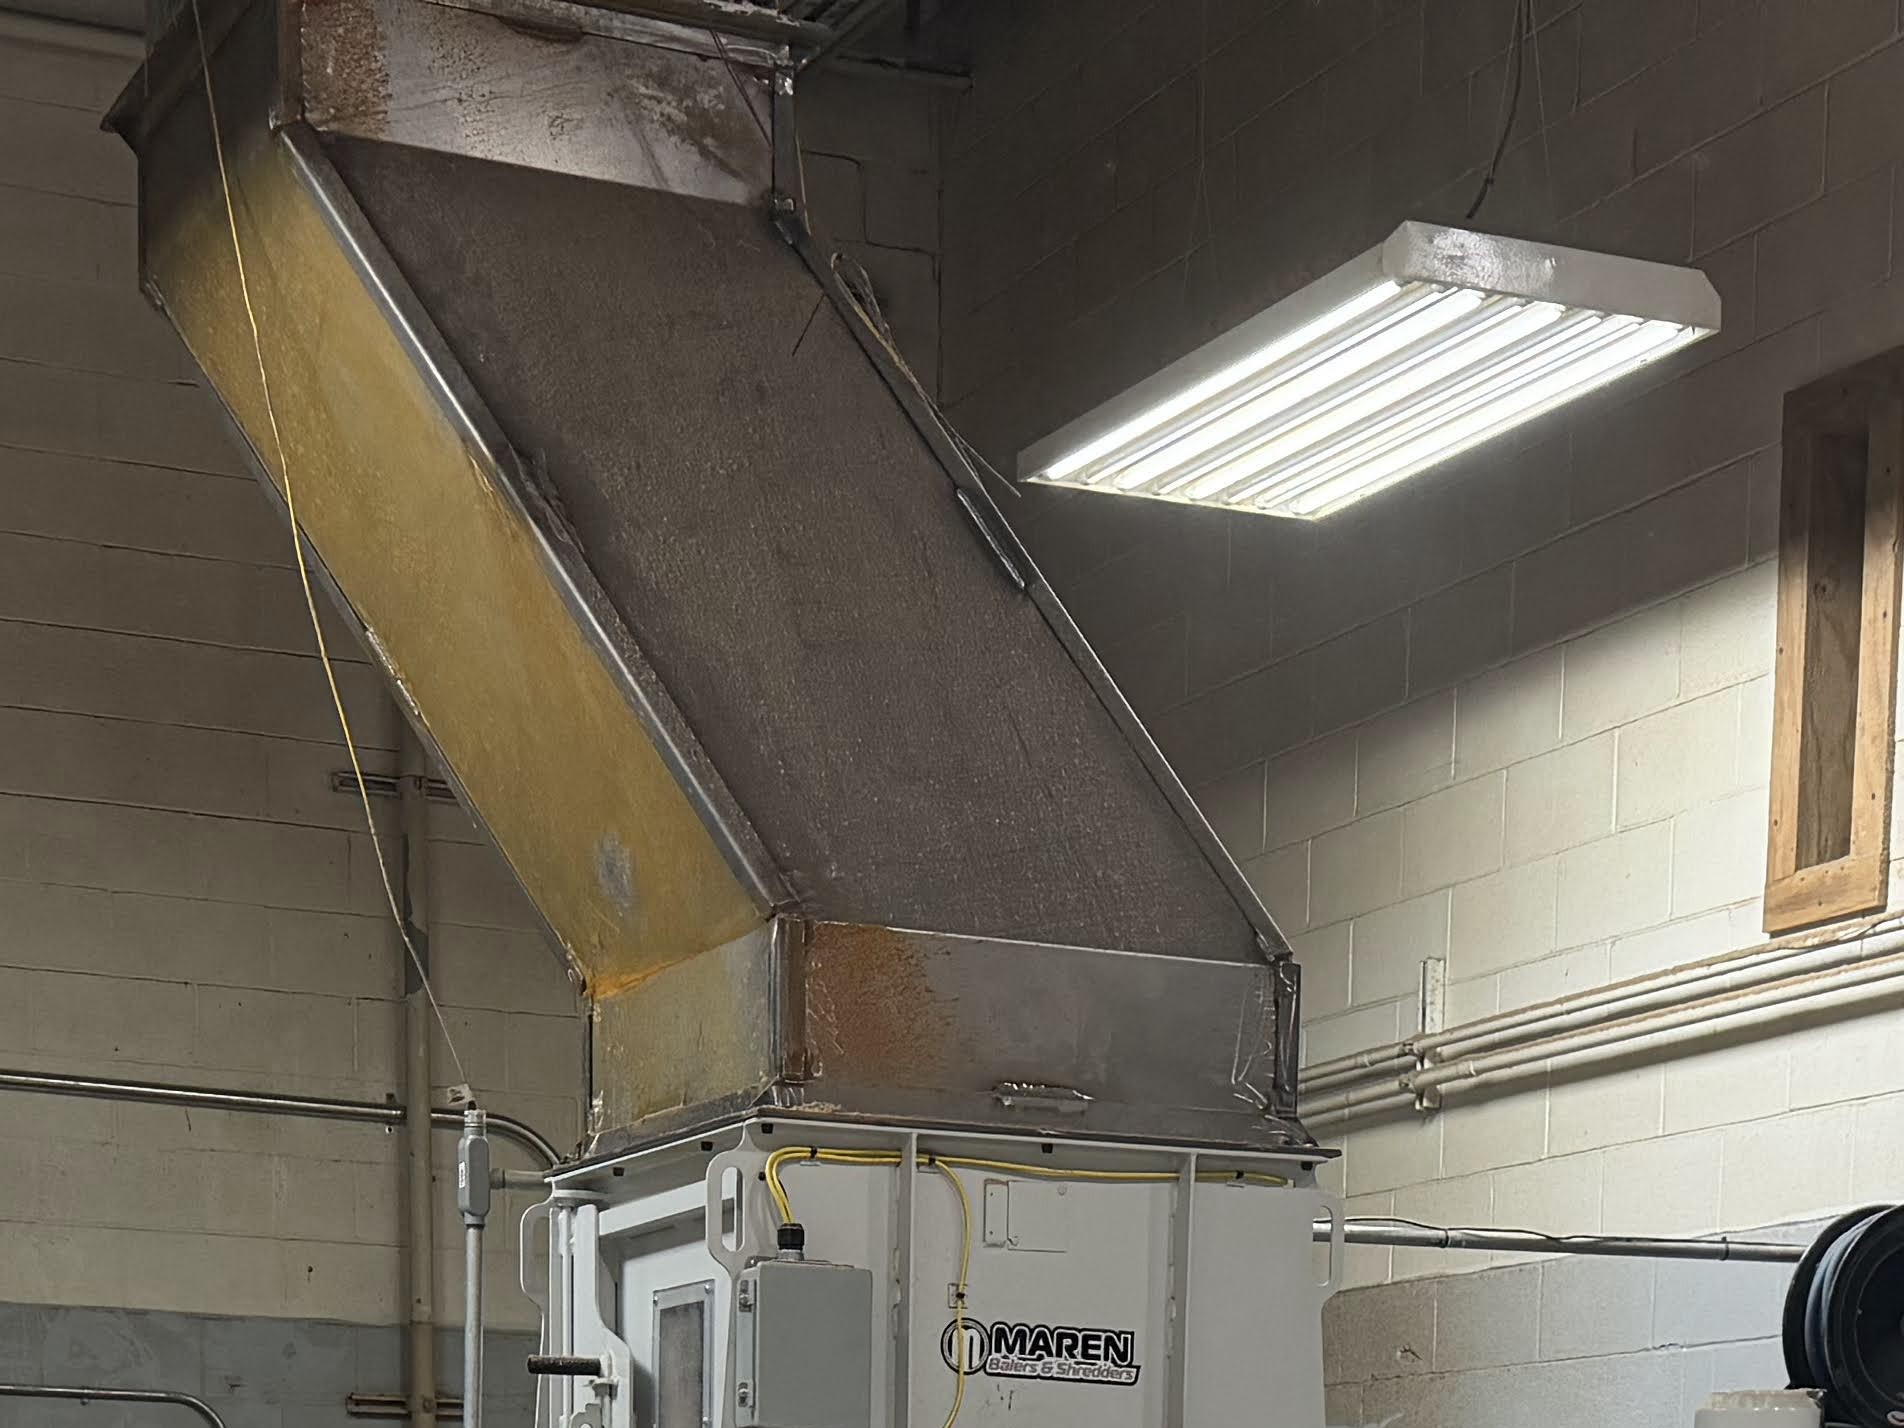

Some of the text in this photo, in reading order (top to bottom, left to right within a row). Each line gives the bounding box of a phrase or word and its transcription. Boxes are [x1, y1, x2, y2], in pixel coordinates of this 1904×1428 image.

[992, 1326, 1131, 1366] MAREN
[988, 1358, 1134, 1380] Balers & Shredders
